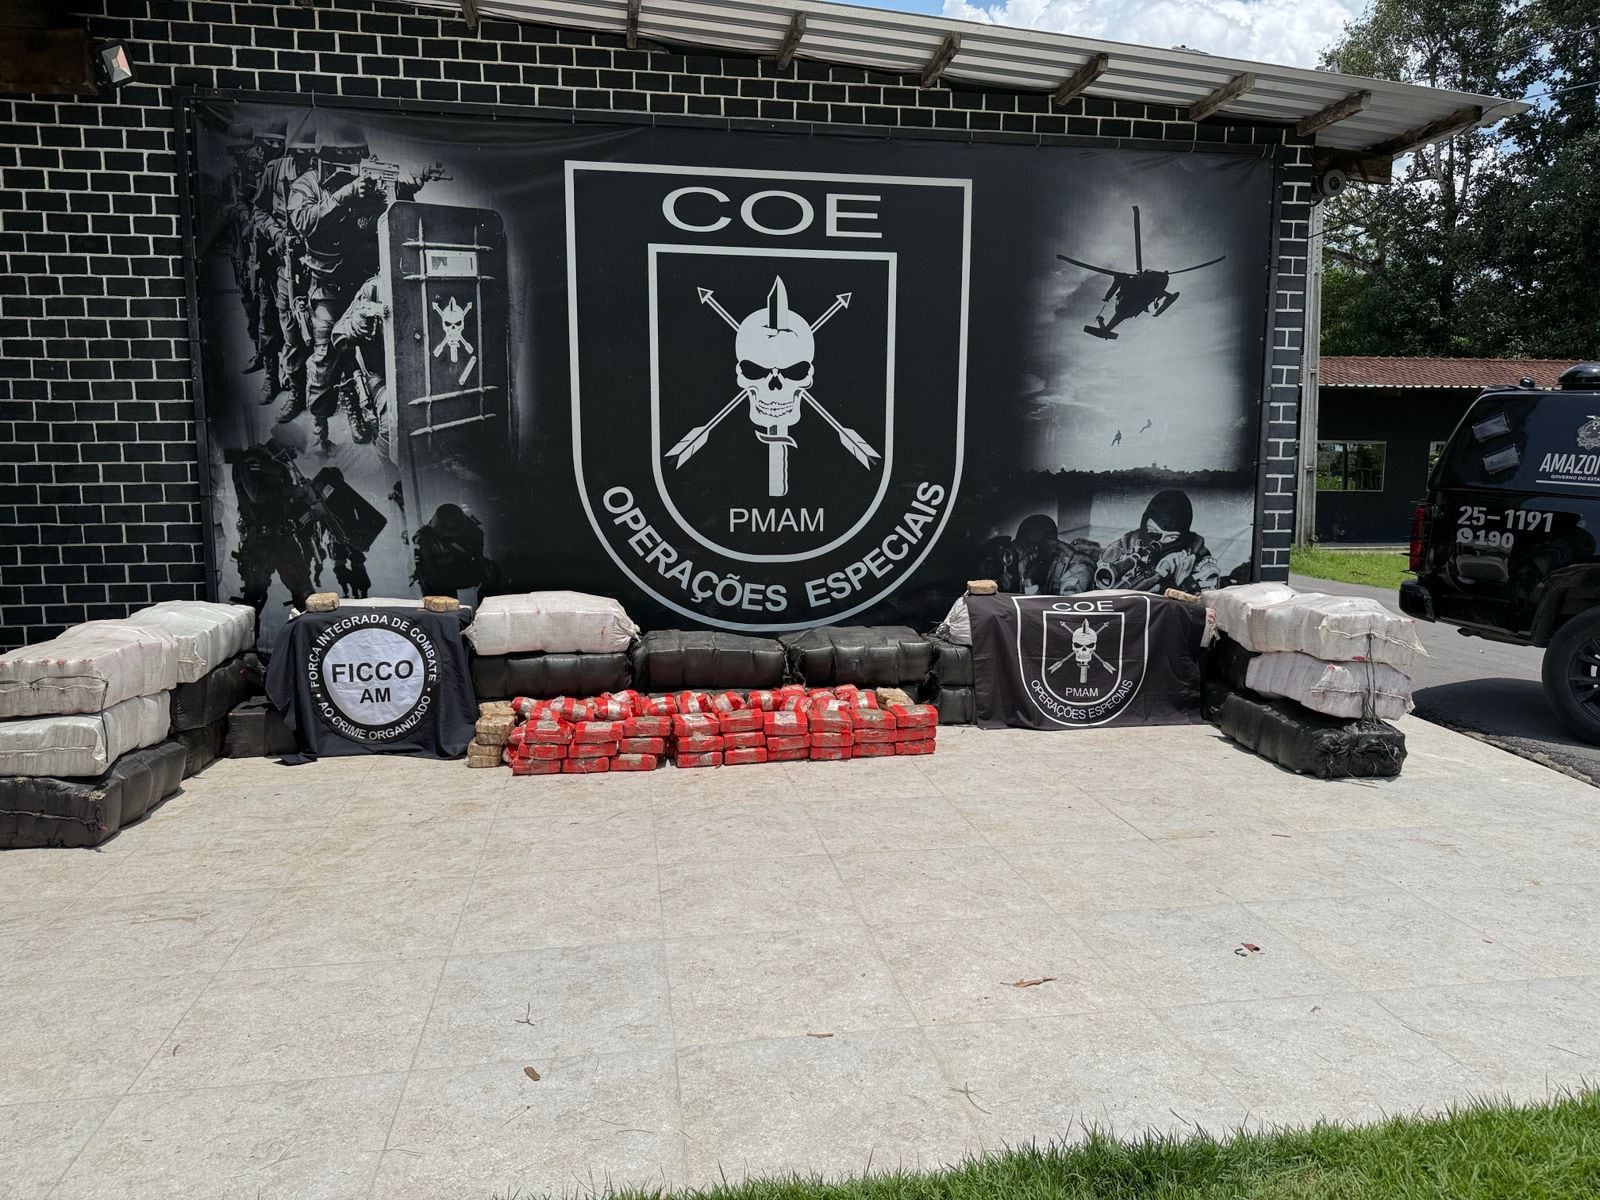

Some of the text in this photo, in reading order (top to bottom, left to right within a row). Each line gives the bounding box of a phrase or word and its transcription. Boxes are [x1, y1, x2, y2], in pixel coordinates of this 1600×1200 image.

[662, 186, 883, 238] COE
[729, 508, 824, 533] PMAM
[1457, 505, 1554, 533] 25-1191
[603, 481, 945, 612] OPERAÇÕES ESPECIAIS
[1475, 529, 1515, 549] 190
[1052, 600, 1115, 612] COE
[308, 614, 437, 688] FORÇA INTEGRADA DE COMBATE
[331, 660, 414, 683] FICCO
[359, 687, 391, 704] AM
[1031, 678, 1134, 720] OPERAÇÕES ESPECIAIS
[1065, 687, 1099, 698] PMAM
[318, 695, 431, 741] AO CRIME ORGANIZADO
